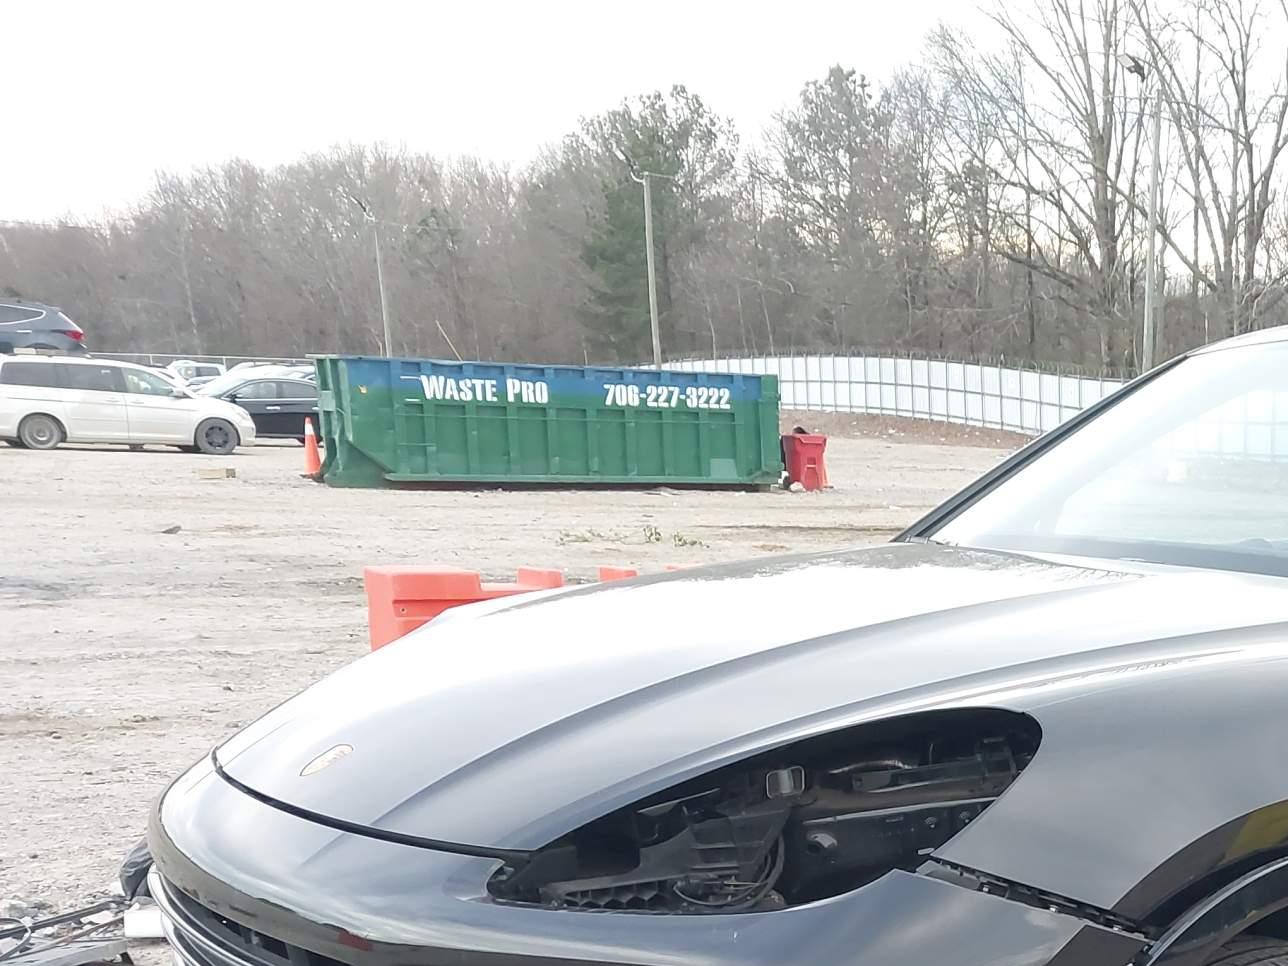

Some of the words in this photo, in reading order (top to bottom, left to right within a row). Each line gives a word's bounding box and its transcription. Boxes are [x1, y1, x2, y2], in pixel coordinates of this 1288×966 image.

[420, 375, 498, 402] WASTE
[506, 378, 549, 404] PRO
[603, 383, 731, 410] 706-227-3222
